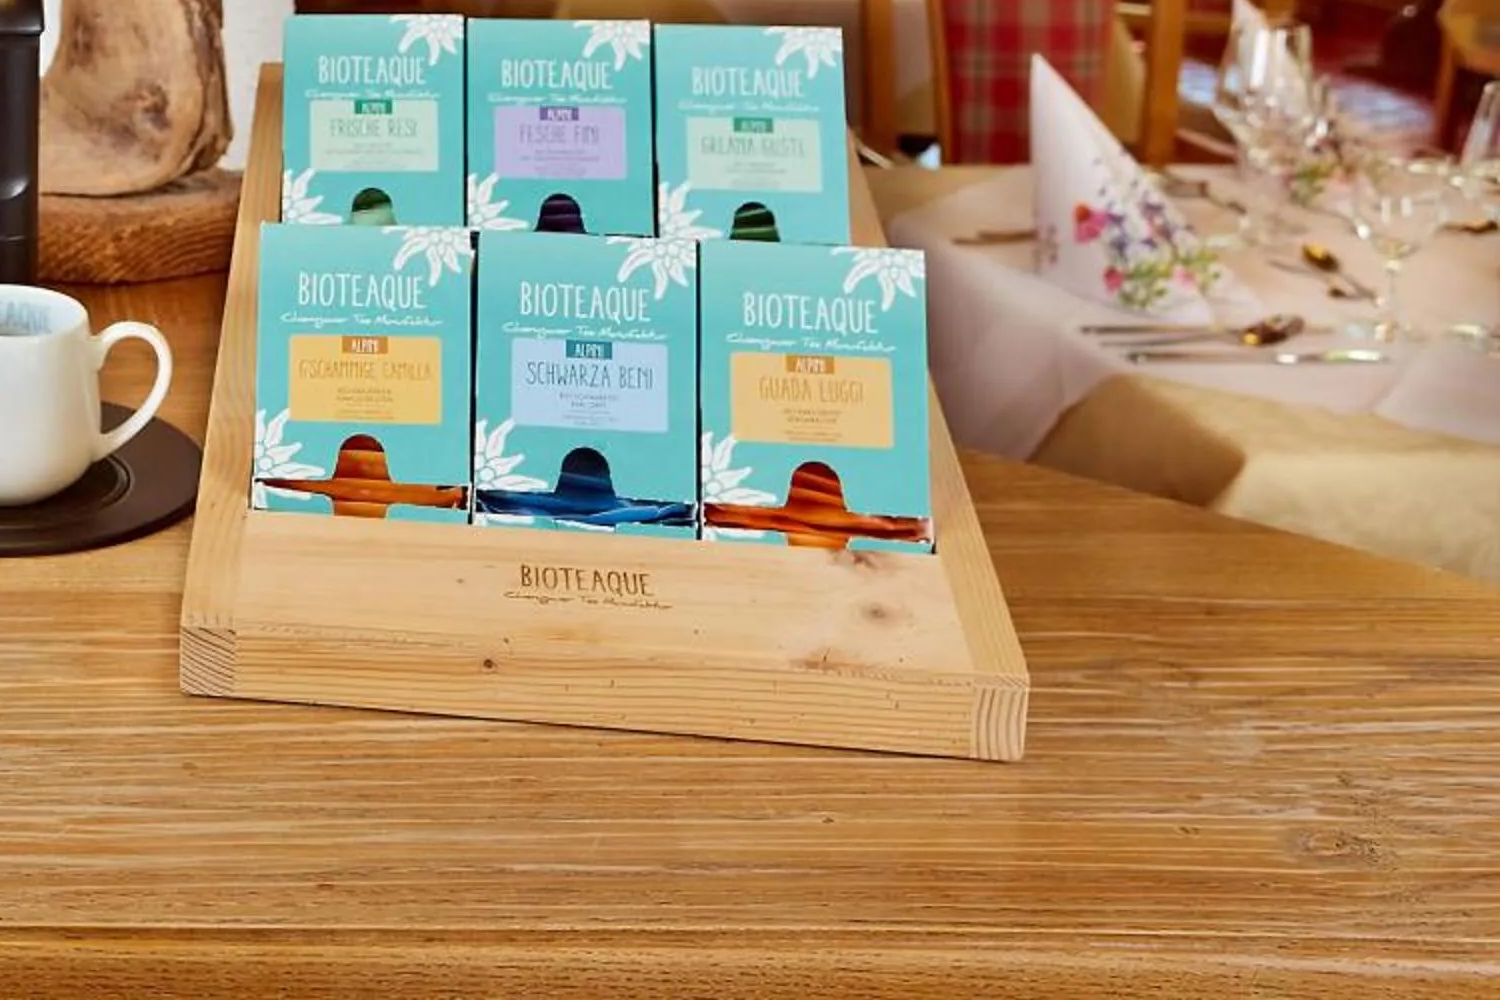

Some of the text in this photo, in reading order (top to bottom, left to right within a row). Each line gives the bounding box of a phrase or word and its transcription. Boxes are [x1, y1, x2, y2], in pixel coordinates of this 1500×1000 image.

[318, 54, 427, 86] BIOTEAQUE
[501, 59, 613, 91] BIOTEAQUE
[691, 66, 806, 99] BIOTEAQUE
[299, 271, 428, 312] BIOTEAQUE
[520, 280, 652, 324] BIOTEAQUE
[742, 290, 879, 335] BIOTEAQUE
[525, 361, 654, 390] SCHWARZA BENI
[521, 563, 655, 597] BIOTEAQUE
